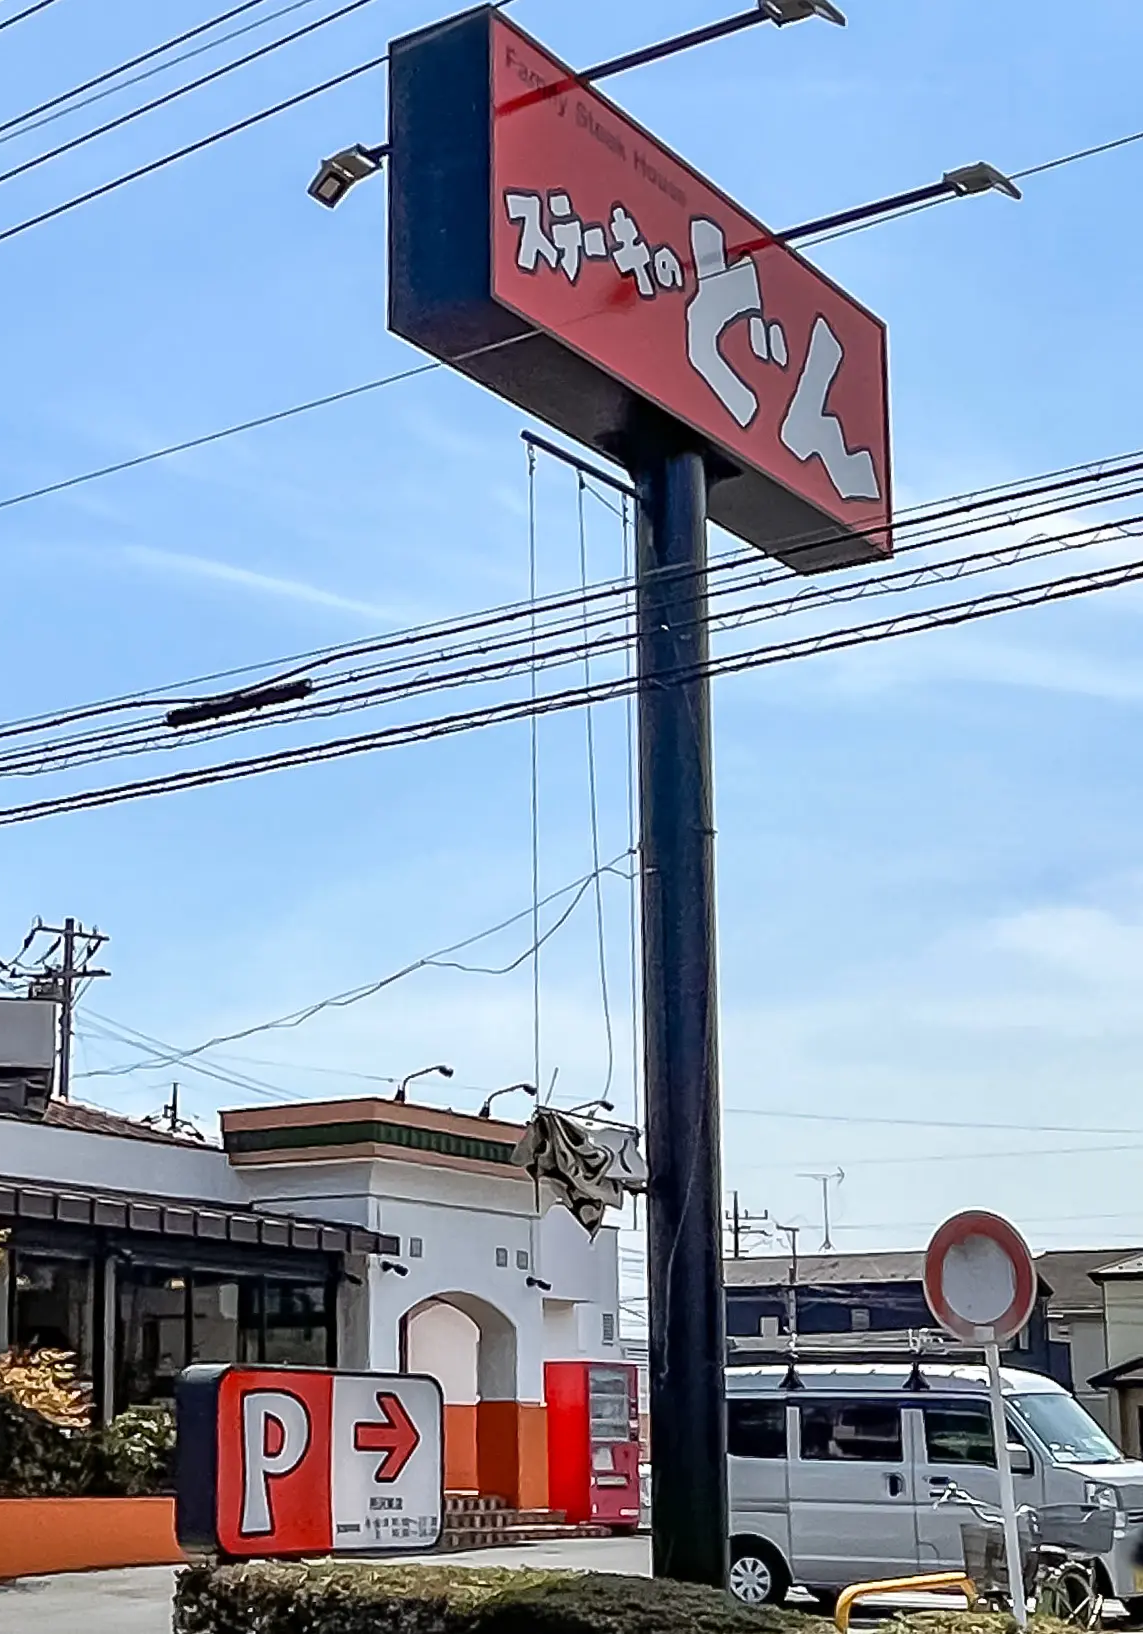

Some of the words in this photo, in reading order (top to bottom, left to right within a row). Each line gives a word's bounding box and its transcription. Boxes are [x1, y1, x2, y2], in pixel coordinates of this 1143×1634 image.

[505, 190, 881, 500] ステーキのどん
[241, 1389, 311, 1536] P
